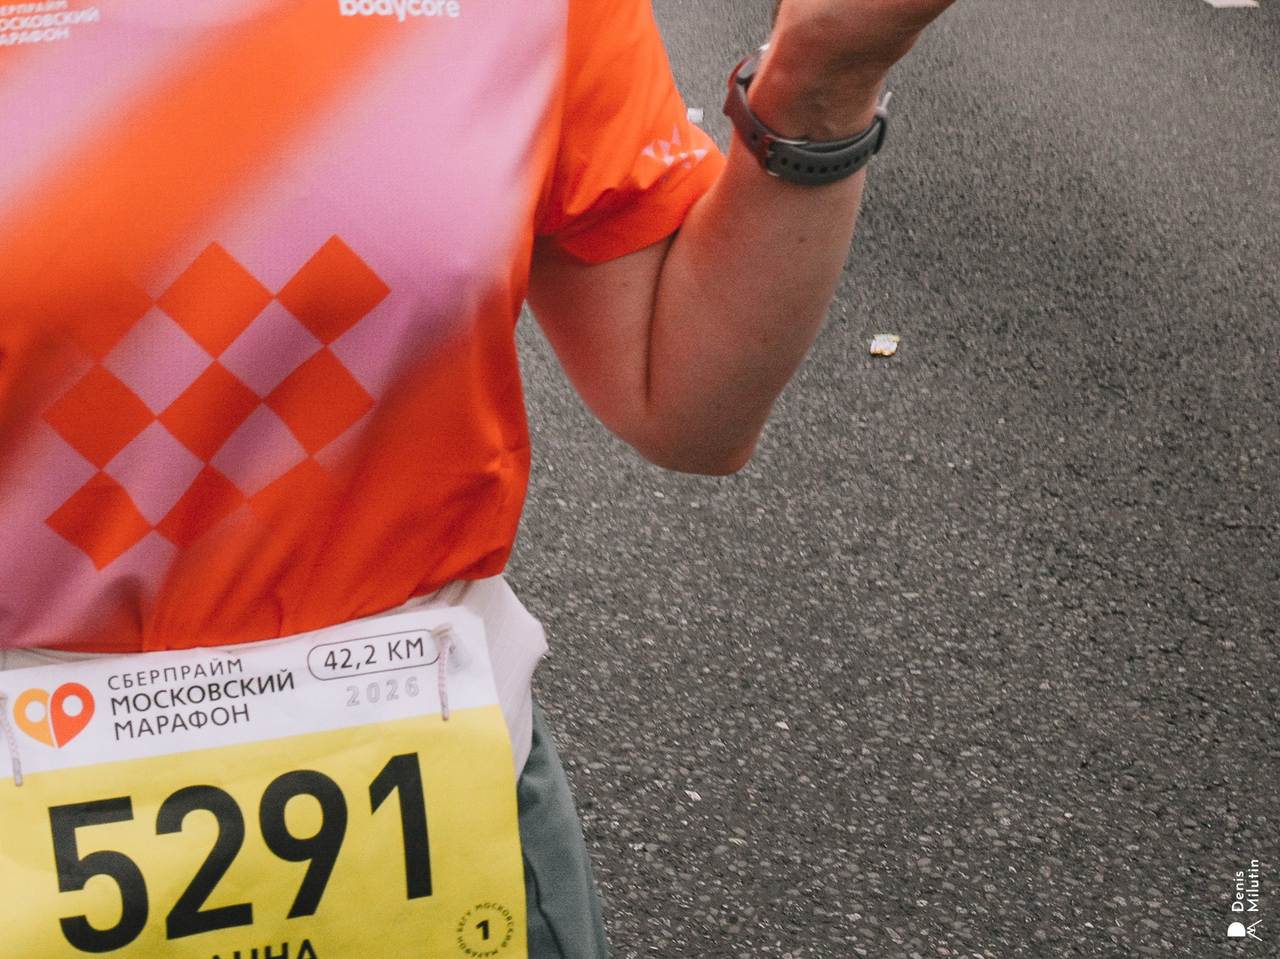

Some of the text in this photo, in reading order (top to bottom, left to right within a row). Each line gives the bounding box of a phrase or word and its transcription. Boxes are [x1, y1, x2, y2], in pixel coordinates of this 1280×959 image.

[324, 645, 377, 670] 42,2
[108, 658, 243, 690] СБЕРПРАЙМ
[110, 668, 295, 716] МОСКОВСКИЙ
[346, 676, 419, 707] 2026
[114, 703, 250, 741] МАРАФОН
[48, 752, 433, 953] 5291
[476, 920, 489, 940] 1
